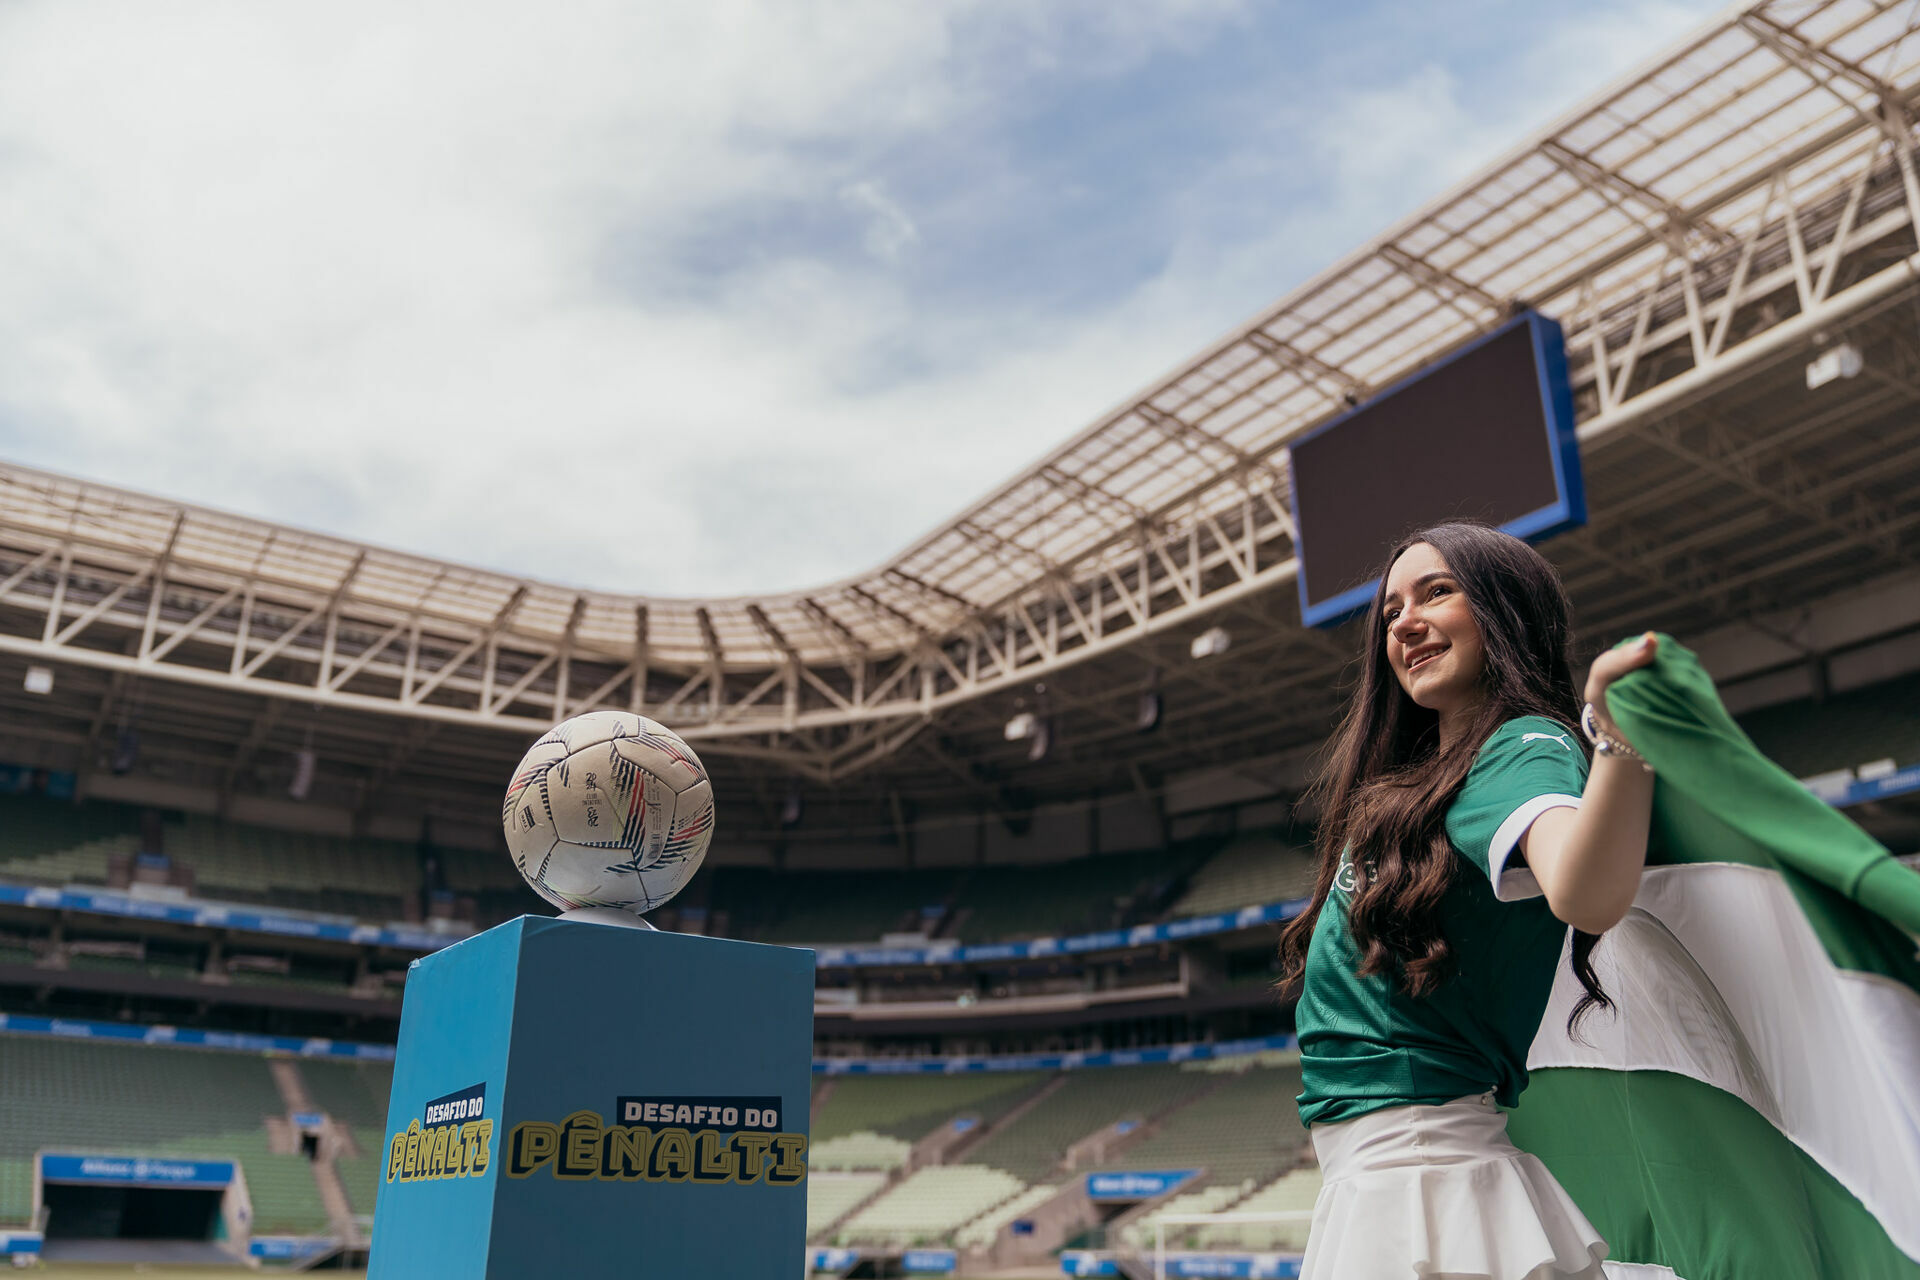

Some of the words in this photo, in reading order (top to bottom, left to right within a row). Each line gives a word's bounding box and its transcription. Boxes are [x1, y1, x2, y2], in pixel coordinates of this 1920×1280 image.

[425, 1099, 468, 1124] DESAFIO
[467, 1097, 484, 1118] DO
[625, 1101, 738, 1127] DESAFIO
[744, 1108, 778, 1128] DO
[387, 1118, 493, 1184] PÊNALTI
[505, 1110, 808, 1186] PÊNALTI
